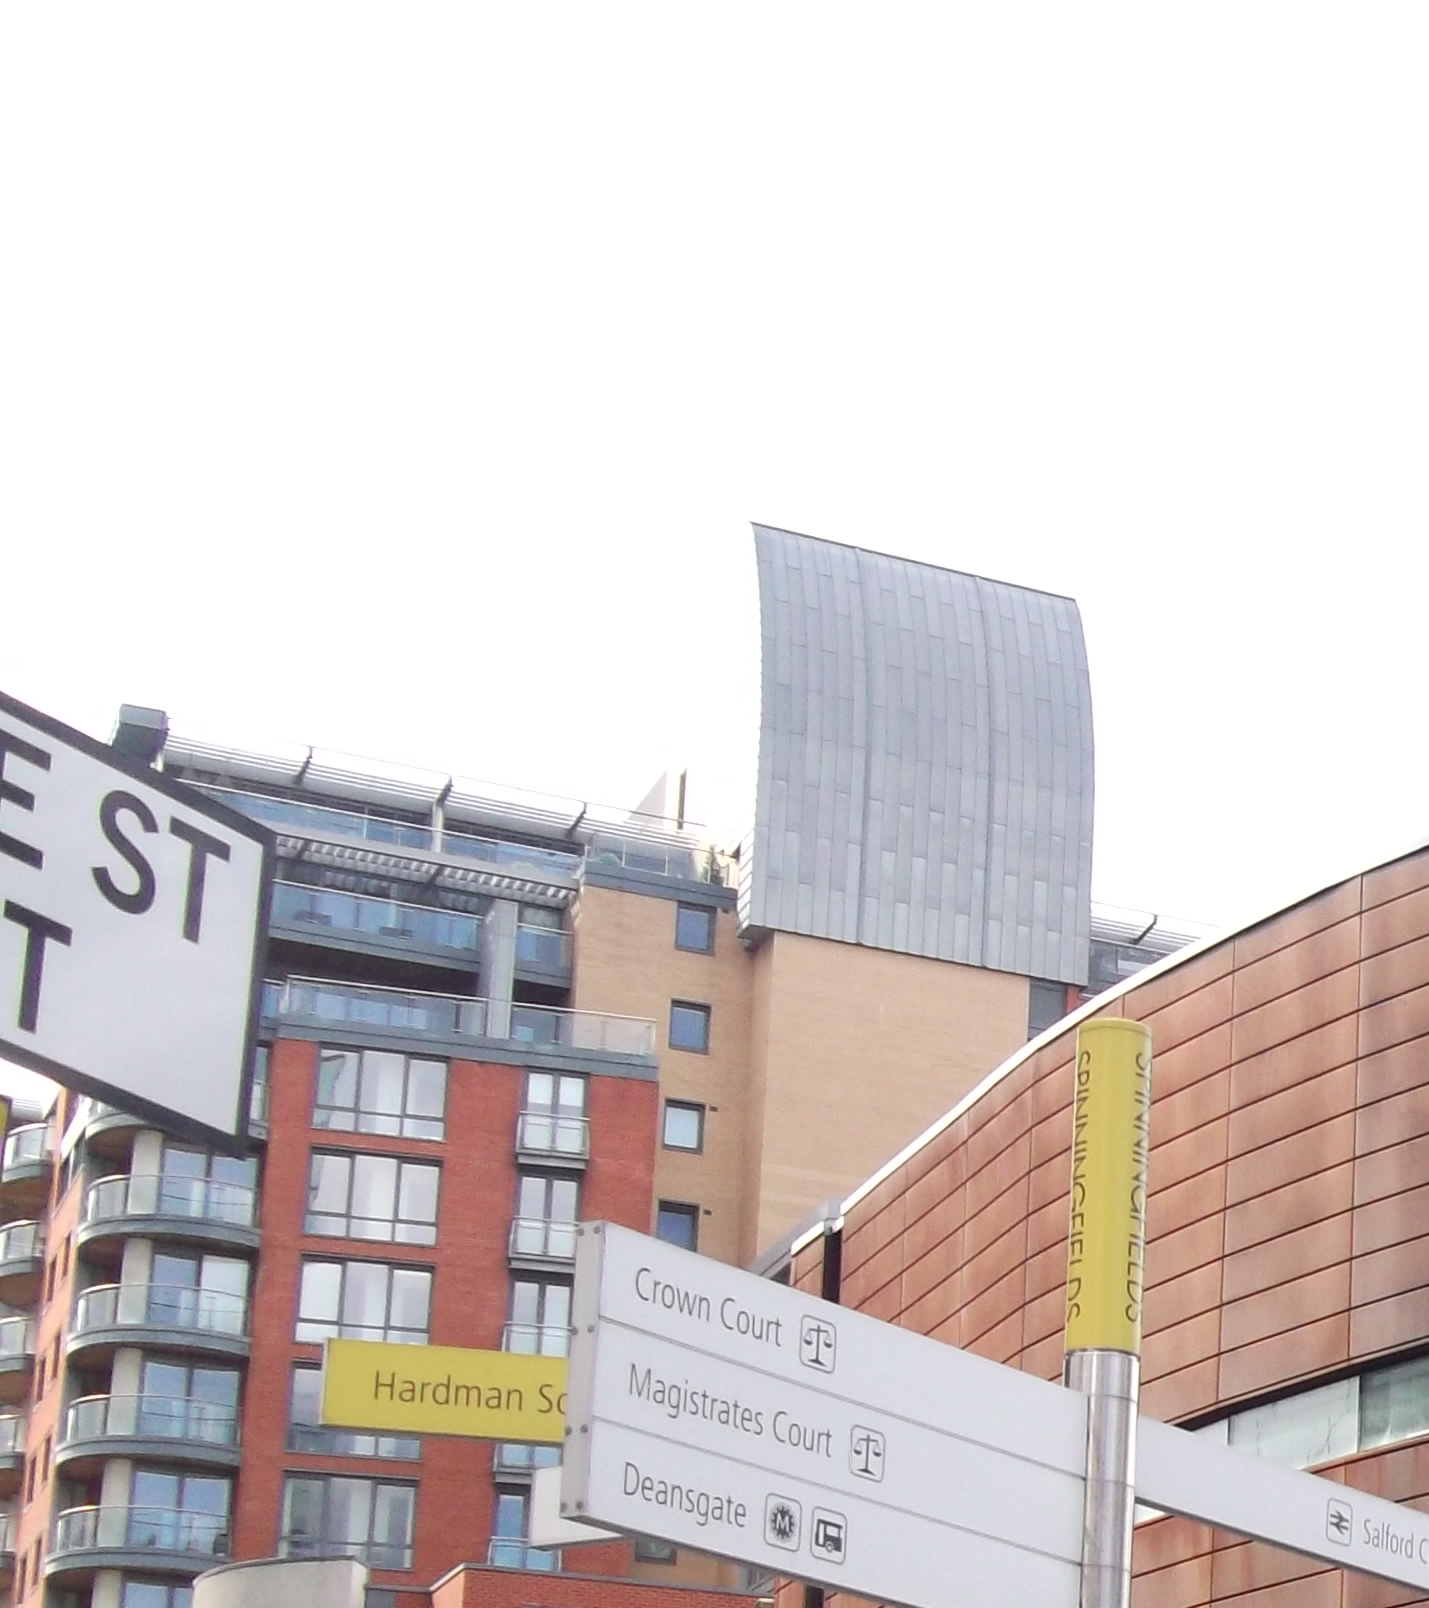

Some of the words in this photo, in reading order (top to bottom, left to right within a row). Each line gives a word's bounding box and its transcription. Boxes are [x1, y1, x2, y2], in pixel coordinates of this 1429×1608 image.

[91, 789, 231, 945] ST
[3, 899, 73, 1034] T
[634, 1266, 712, 1323] Crown
[720, 1296, 783, 1348] Court
[373, 1370, 523, 1412] Hardman
[629, 1362, 765, 1437] Magistrates
[772, 1410, 834, 1459] Court
[623, 1461, 747, 1528] Deansgate
[1362, 1518, 1414, 1560] Salford
